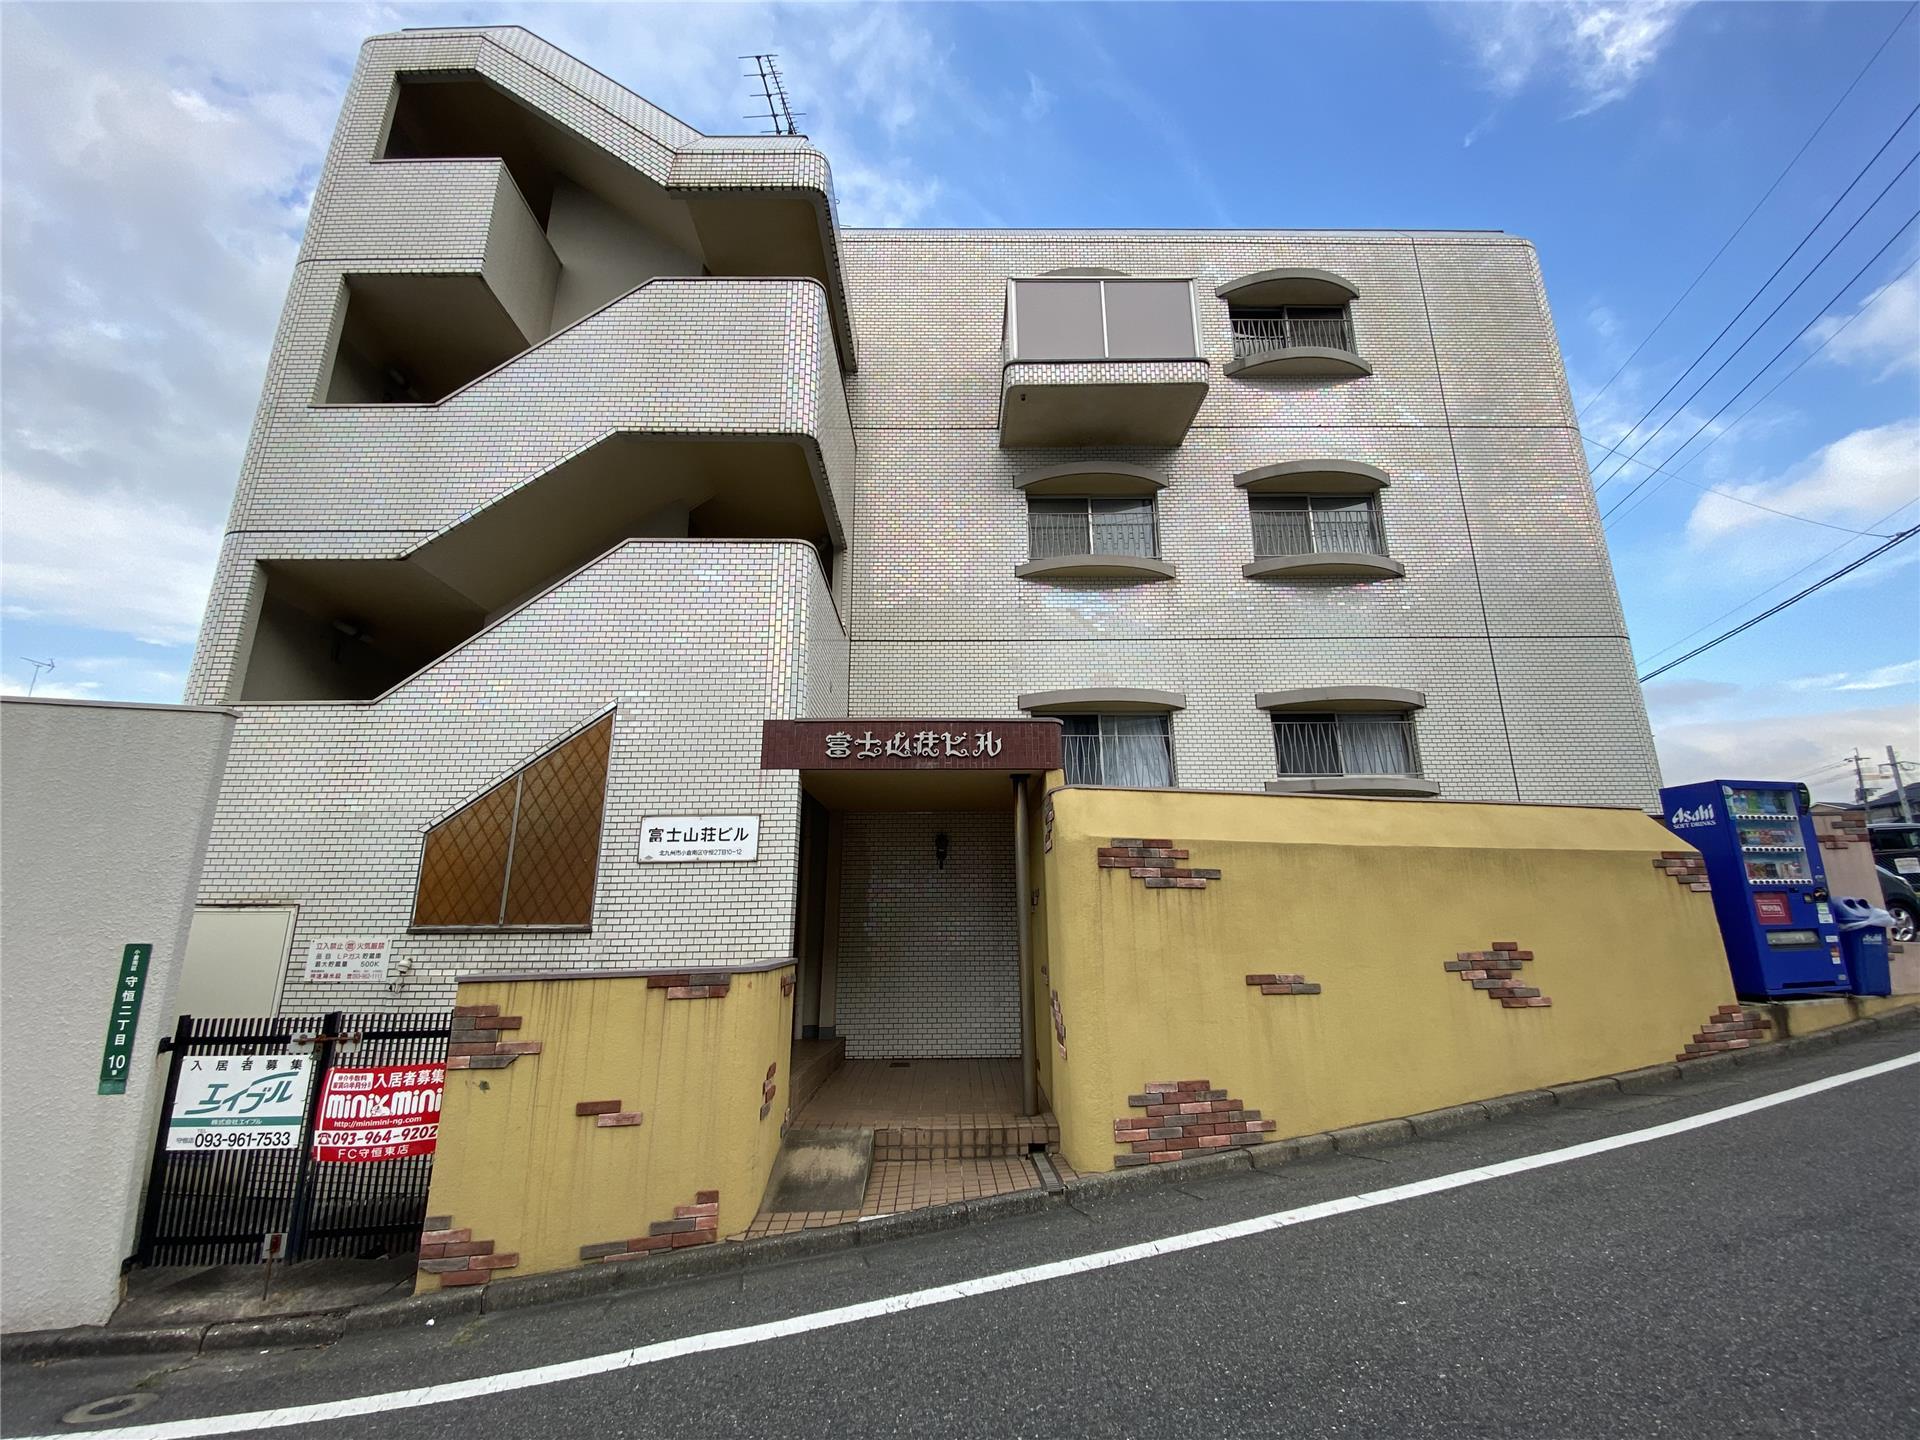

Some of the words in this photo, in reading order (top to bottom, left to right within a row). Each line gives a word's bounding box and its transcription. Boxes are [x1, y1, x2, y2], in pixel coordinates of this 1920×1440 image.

[825, 730, 1002, 760] 富士山荘ビル
[1671, 803, 1714, 824] Asahi
[648, 826, 749, 843] 富士山荘ビル
[114, 976, 138, 1046] 守恒二丁目
[108, 1054, 126, 1069] 10
[190, 1059, 303, 1071] 入居者募集
[373, 1068, 445, 1089] 入居者募集
[196, 1072, 299, 1114] エイブル
[210, 1118, 263, 1126] 株式会社エイブル
[194, 1131, 290, 1148] 093-961-7533
[332, 1125, 438, 1145] 093-964-9202
[337, 1144, 409, 1159] FC守恒東店
